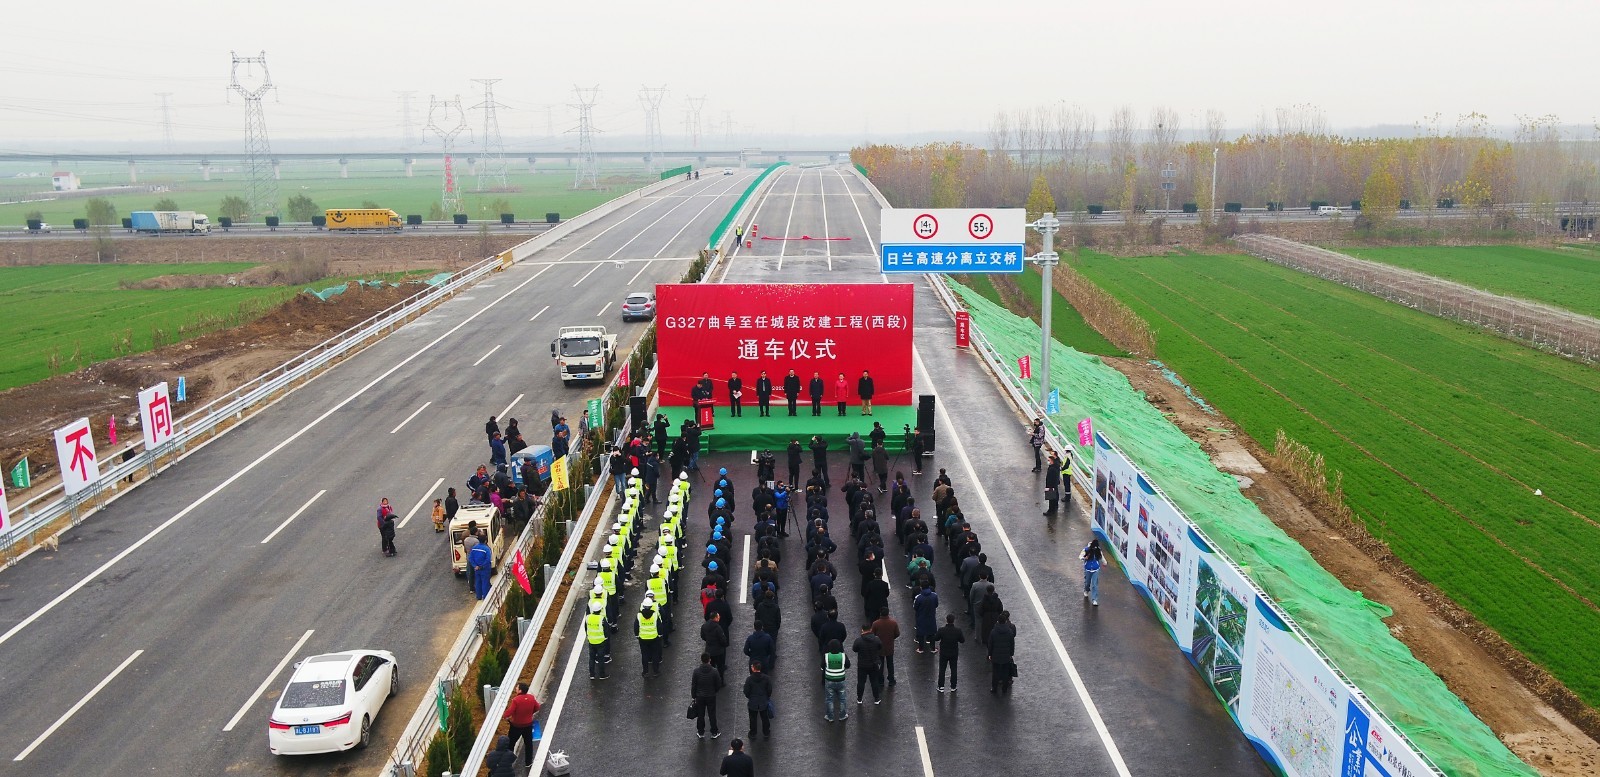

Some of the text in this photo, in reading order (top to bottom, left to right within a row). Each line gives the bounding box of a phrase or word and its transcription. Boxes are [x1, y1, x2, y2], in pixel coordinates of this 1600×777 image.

[973, 222, 988, 232] 55t
[887, 252, 1017, 266] 日兰高速分离立交桥
[665, 314, 908, 331] G327曲阜至任城段改建工程(西段)
[737, 338, 837, 361] 通车仪式
[149, 391, 173, 443] 向
[65, 426, 94, 482] 不
